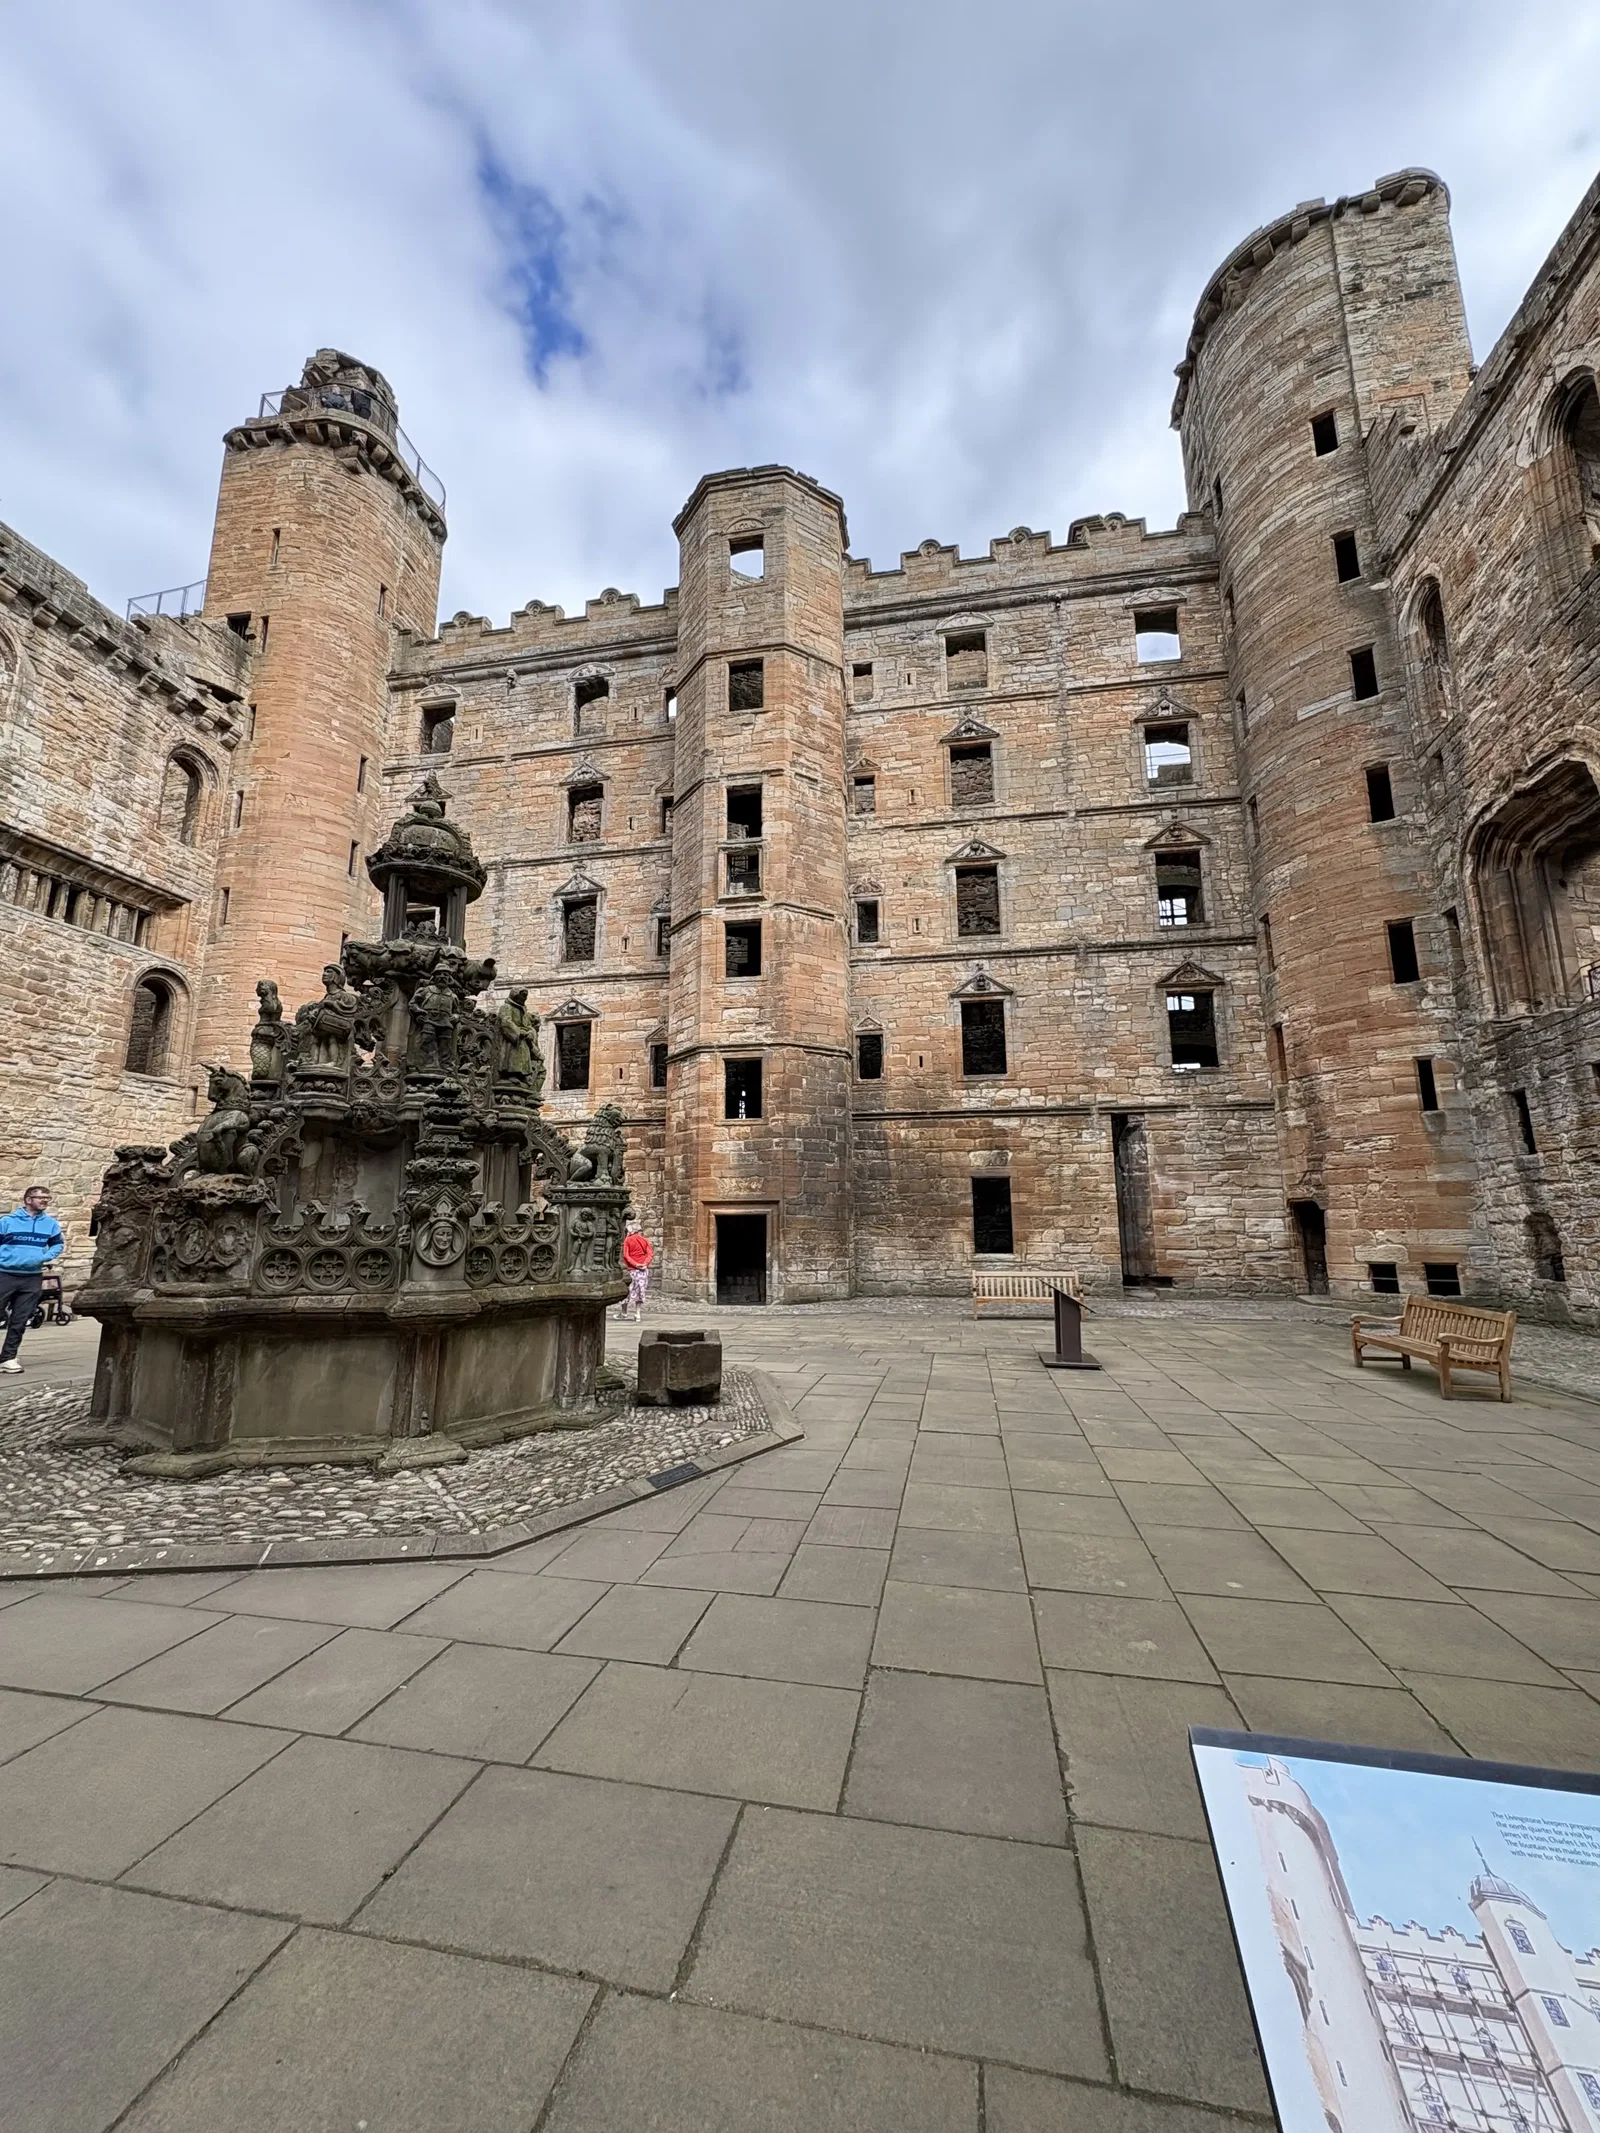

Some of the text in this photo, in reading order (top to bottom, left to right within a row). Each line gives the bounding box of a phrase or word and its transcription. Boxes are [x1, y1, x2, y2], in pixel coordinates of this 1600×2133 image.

[1491, 1811, 1504, 1819] The
[1504, 1813, 1542, 1824] Livingstone
[1541, 1818, 1569, 1828] keepers
[1500, 1830, 1522, 1839] James
[1548, 1836, 1574, 1846] Charles
[1579, 1840, 1588, 1848] in
[1552, 1828, 1564, 1836] for
[1583, 1832, 1593, 1841] by
[1504, 1838, 1518, 1847] The
[1518, 1840, 1548, 1850] fountain
[1554, 1855, 1568, 1863] the
